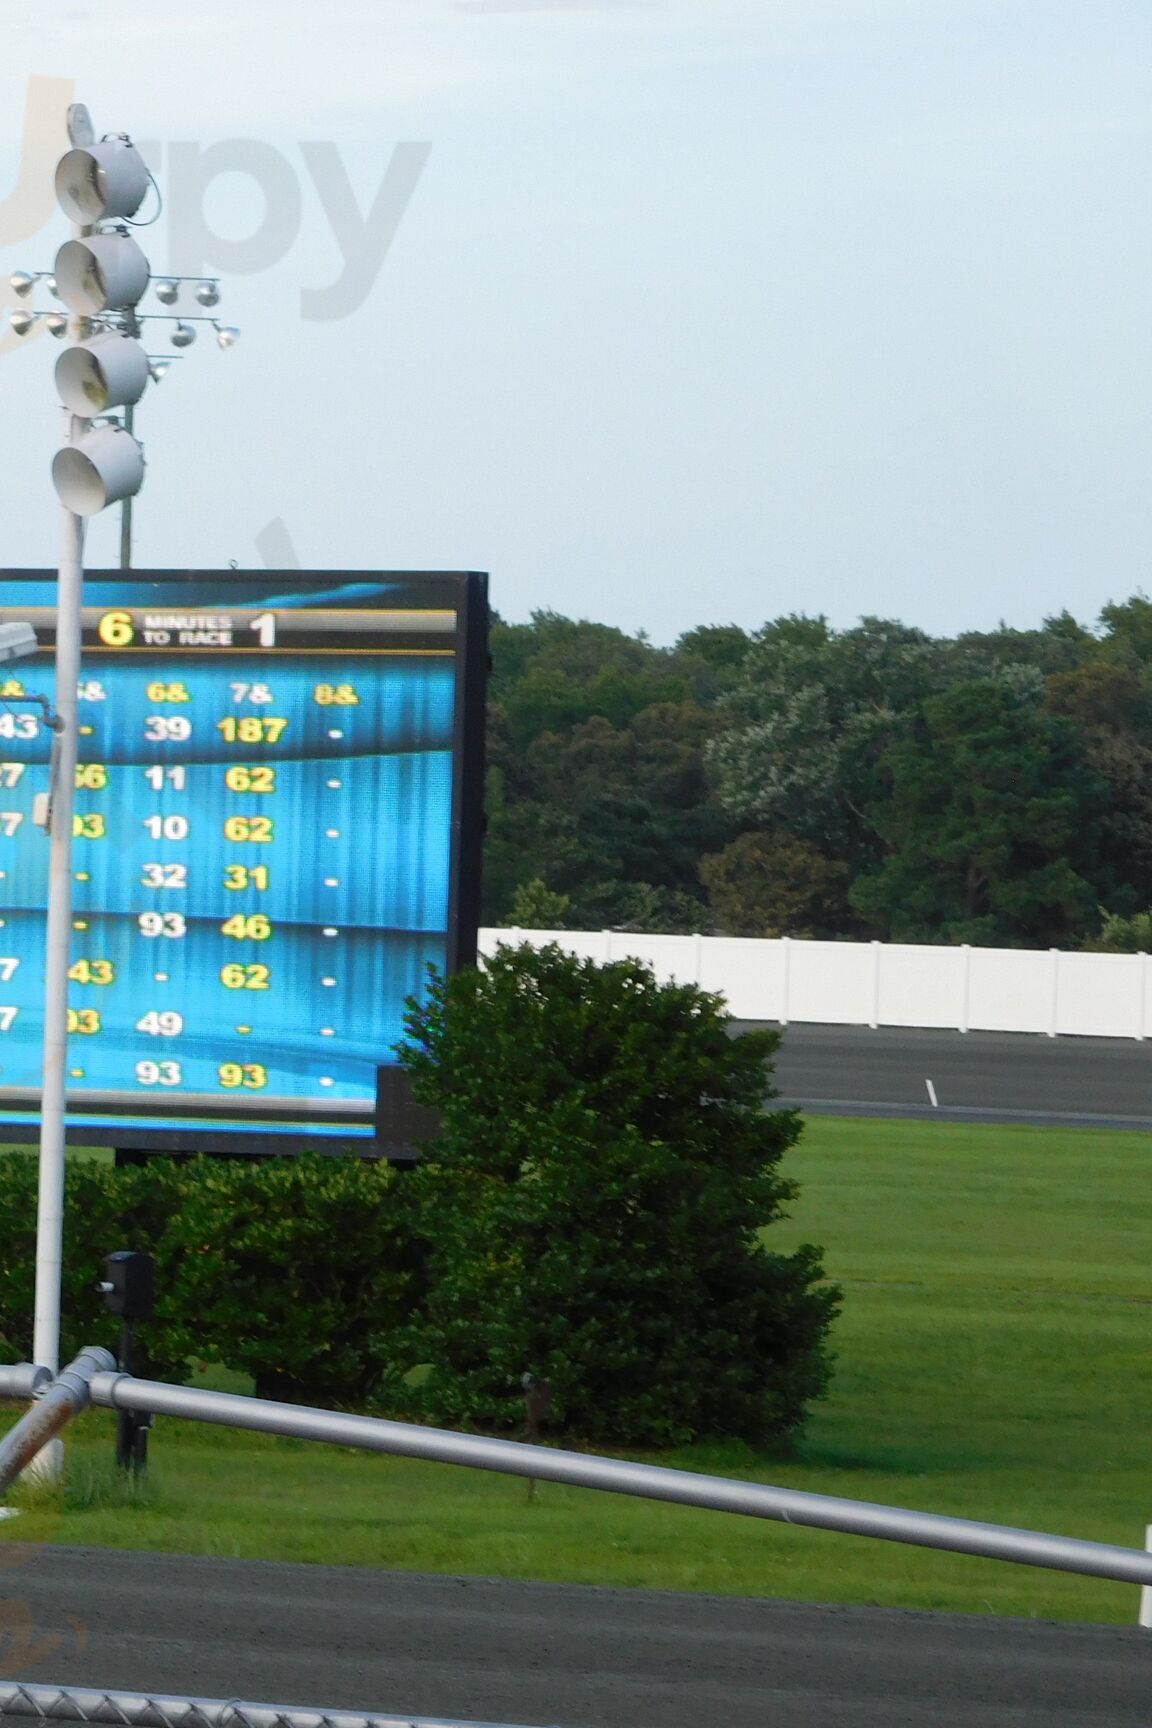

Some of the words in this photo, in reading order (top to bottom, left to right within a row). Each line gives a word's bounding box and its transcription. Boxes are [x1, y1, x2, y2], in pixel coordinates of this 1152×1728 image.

[99, 612, 134, 646] 6
[143, 614, 233, 630] MINUTES
[250, 613, 276, 647] 1
[143, 630, 171, 646] TO
[178, 631, 233, 646] RACE
[144, 715, 192, 742] 39
[217, 716, 288, 743] 187
[144, 765, 186, 791] 11
[225, 766, 276, 793] 62
[143, 815, 190, 841] 10
[223, 816, 274, 843] 62
[140, 863, 188, 889] 32
[223, 864, 269, 891] 31
[138, 911, 187, 939] 93
[221, 913, 271, 941] 46
[220, 963, 270, 990] 62
[135, 1010, 184, 1037] 49
[134, 1060, 183, 1086] 93
[218, 1063, 269, 1090] 93
